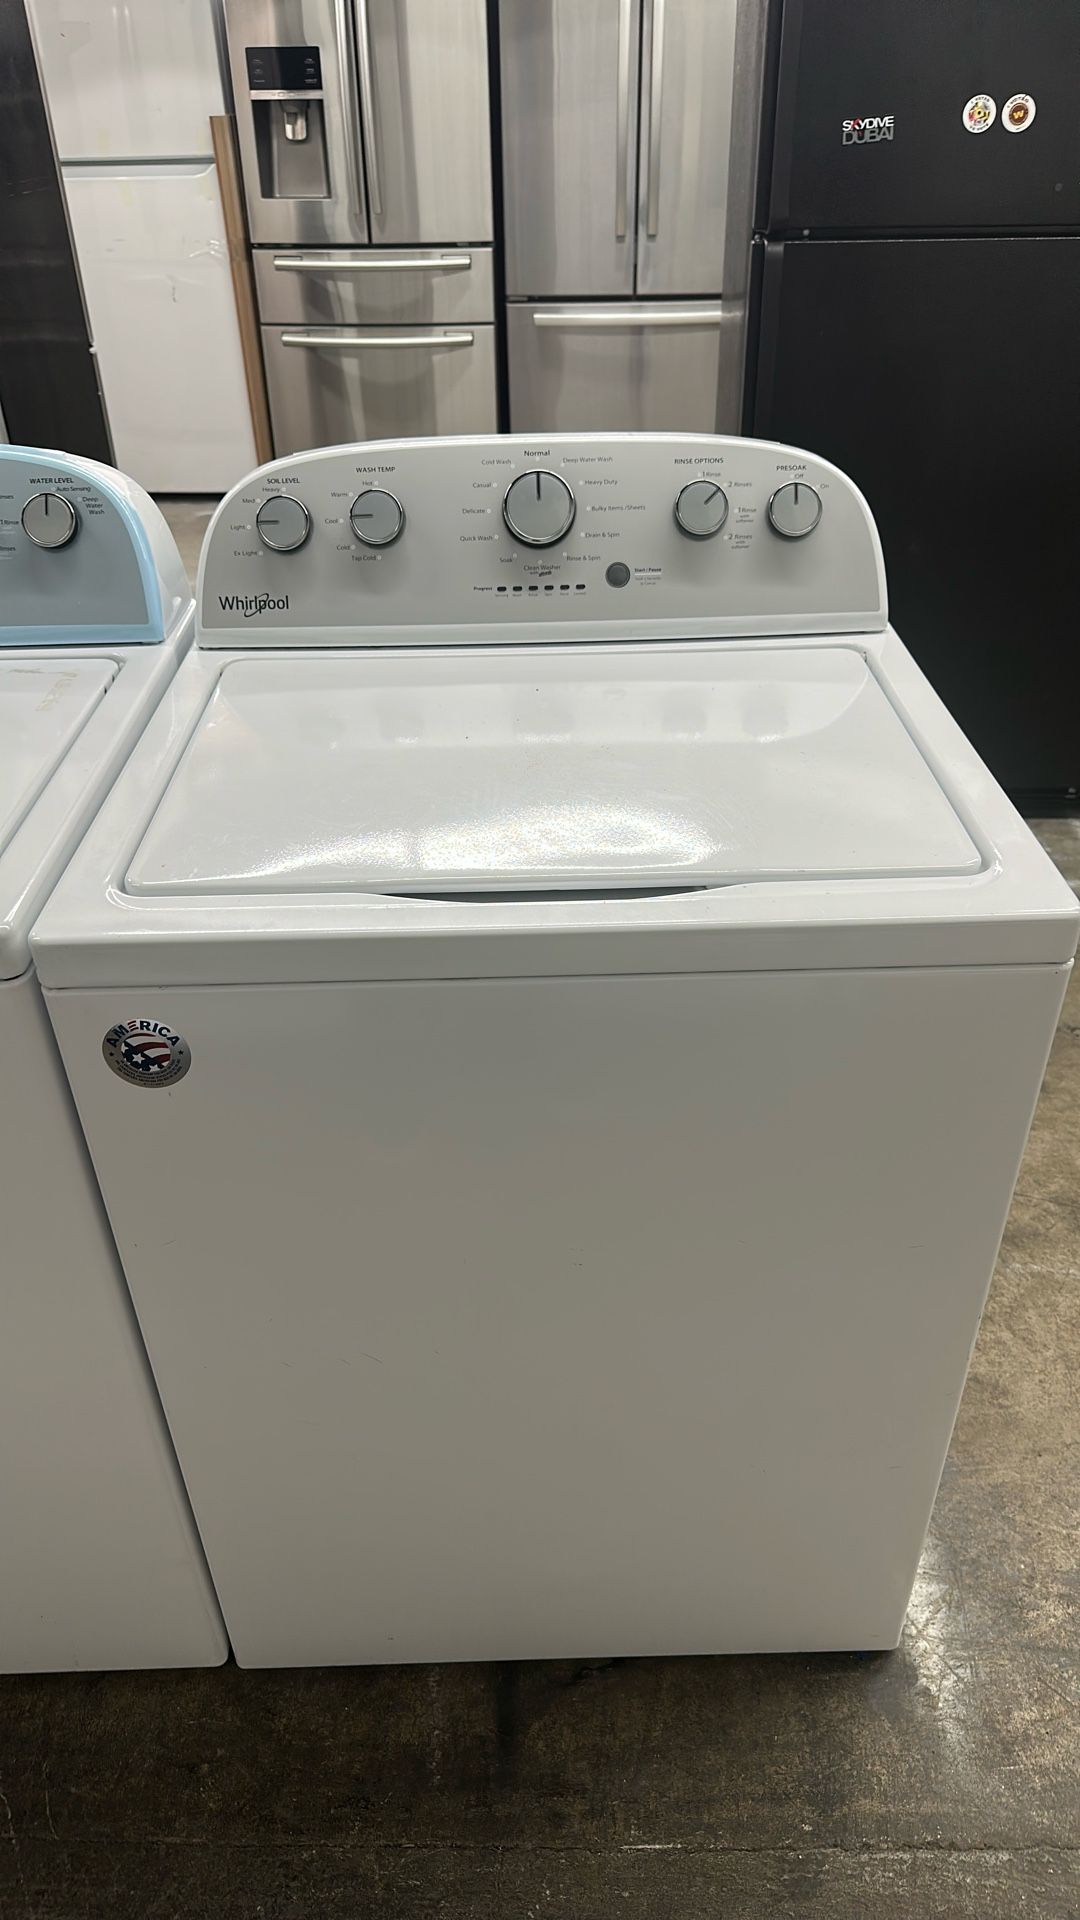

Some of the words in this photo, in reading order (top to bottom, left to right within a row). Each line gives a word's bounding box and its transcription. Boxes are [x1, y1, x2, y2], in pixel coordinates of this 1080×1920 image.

[842, 115, 895, 131] SKYDIVE
[842, 127, 894, 145] DUBAI
[218, 593, 290, 617] Whirlpool
[106, 1020, 180, 1048] AMERICA
